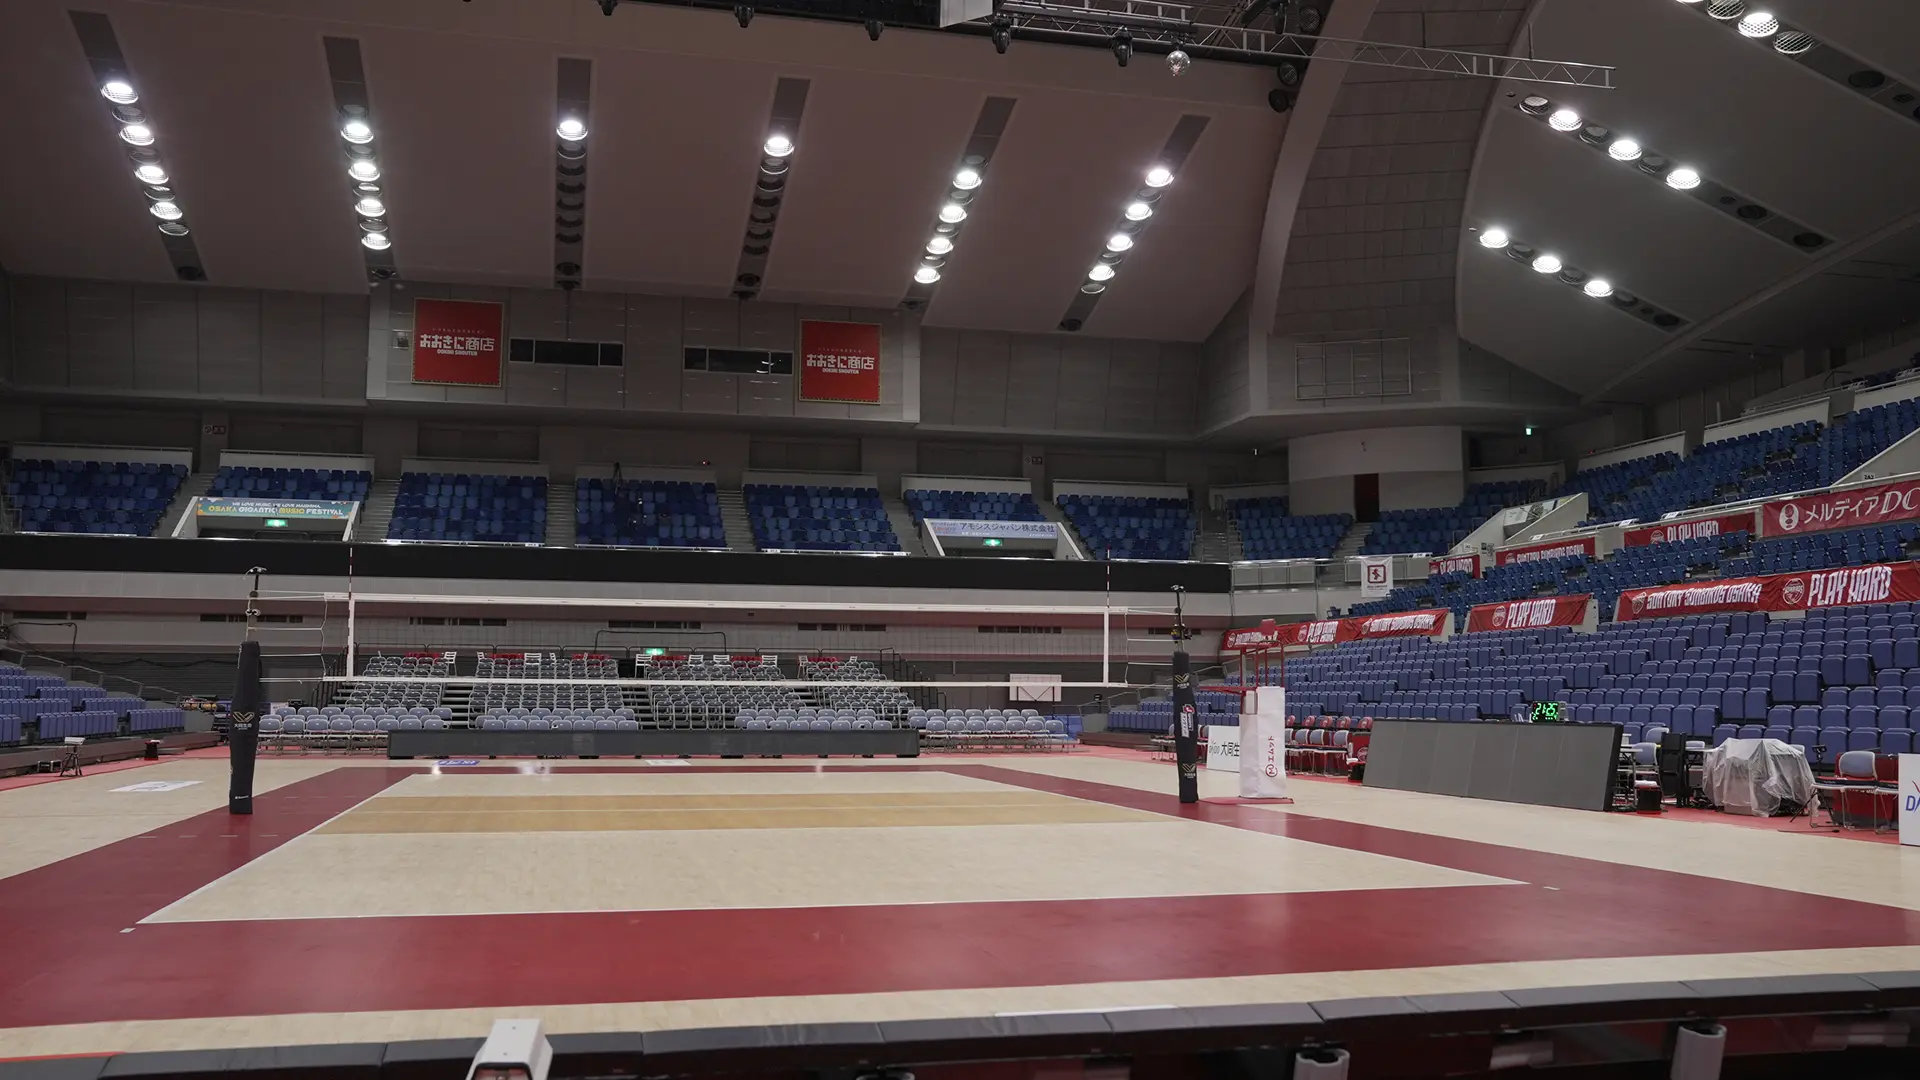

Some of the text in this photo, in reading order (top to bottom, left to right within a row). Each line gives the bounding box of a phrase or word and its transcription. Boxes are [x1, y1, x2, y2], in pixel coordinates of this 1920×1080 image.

[420, 334, 495, 351] おおきに商店
[807, 354, 875, 370] おおきに商店
[278, 507, 305, 515] MUSIC
[1807, 566, 1892, 606] PLAY HARD
[1646, 582, 1763, 610] SUNTORY SUNBIRDS OSAKA
[1505, 599, 1556, 628] PLAY HARD
[1220, 741, 1240, 757] 大同生
